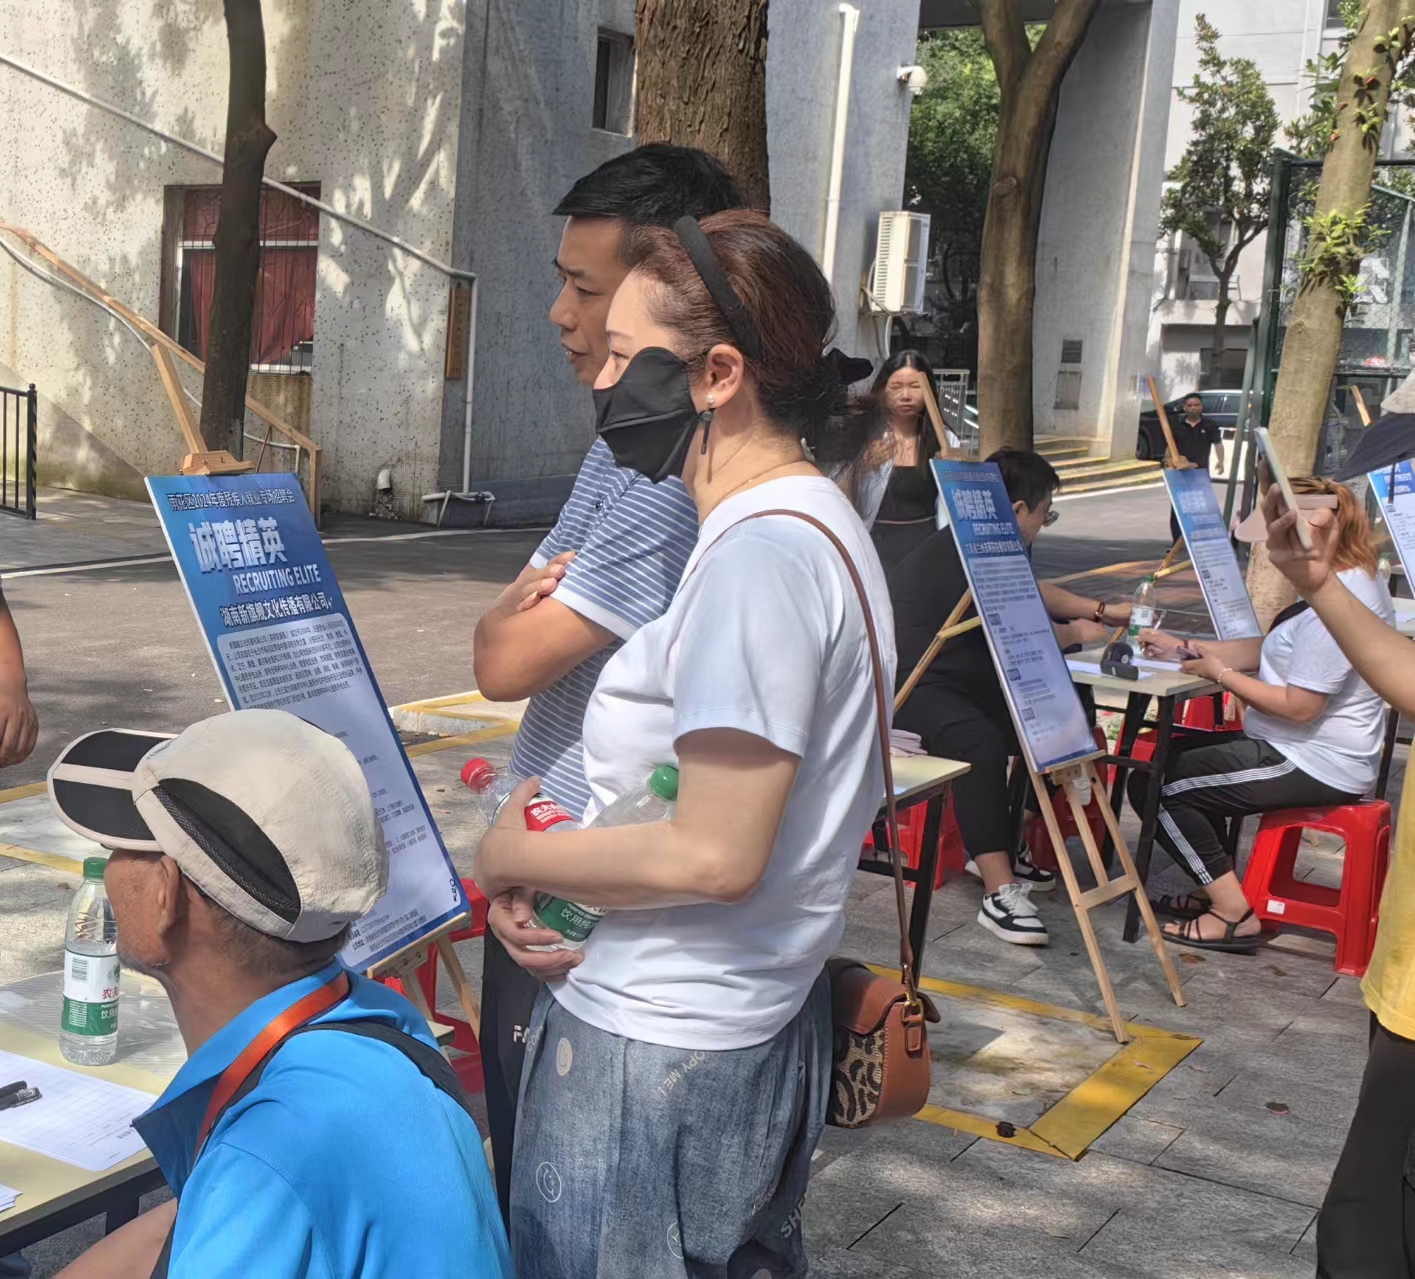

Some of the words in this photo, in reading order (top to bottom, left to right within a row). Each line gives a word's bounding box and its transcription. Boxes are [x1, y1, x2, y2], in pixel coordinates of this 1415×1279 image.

[188, 517, 287, 573] 诚聘精英
[233, 569, 295, 594] RECRUITING
[295, 563, 322, 584] ELITE
